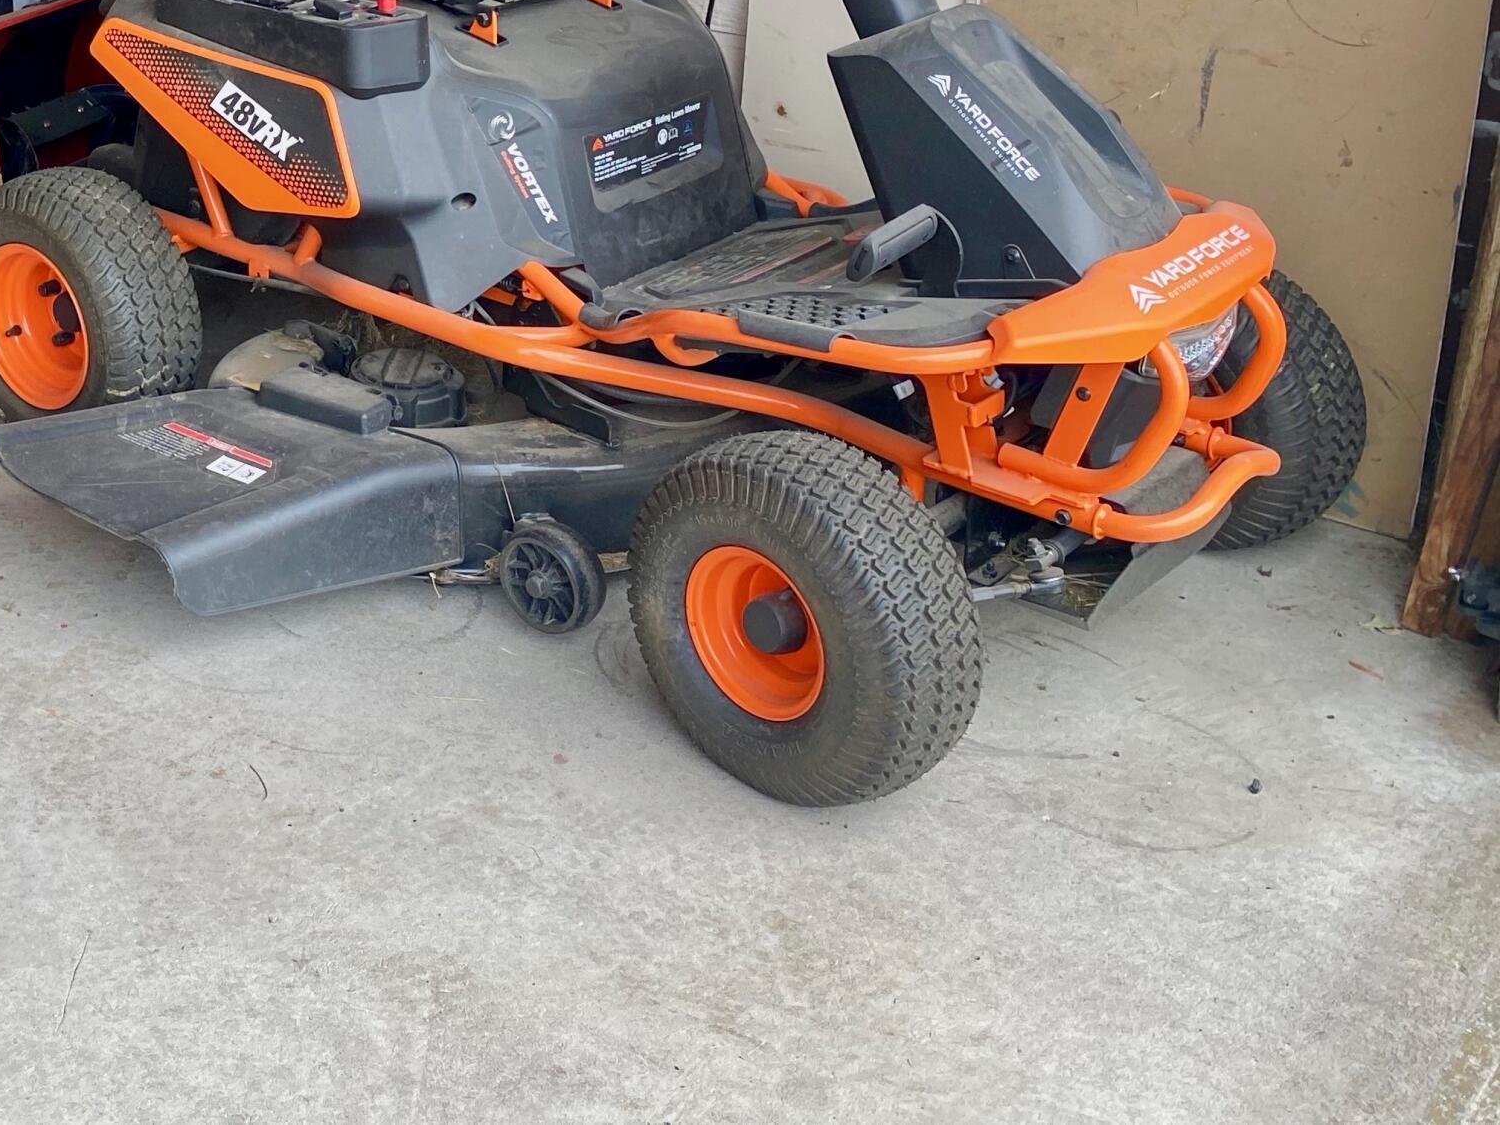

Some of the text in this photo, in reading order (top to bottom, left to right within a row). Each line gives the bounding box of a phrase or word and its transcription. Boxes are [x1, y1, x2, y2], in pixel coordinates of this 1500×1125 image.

[948, 98, 974, 126] OUTDOOR
[954, 85, 1042, 182] YARD FORCE
[507, 142, 558, 224] VORTEX
[1141, 223, 1252, 289] YARD FORCE
